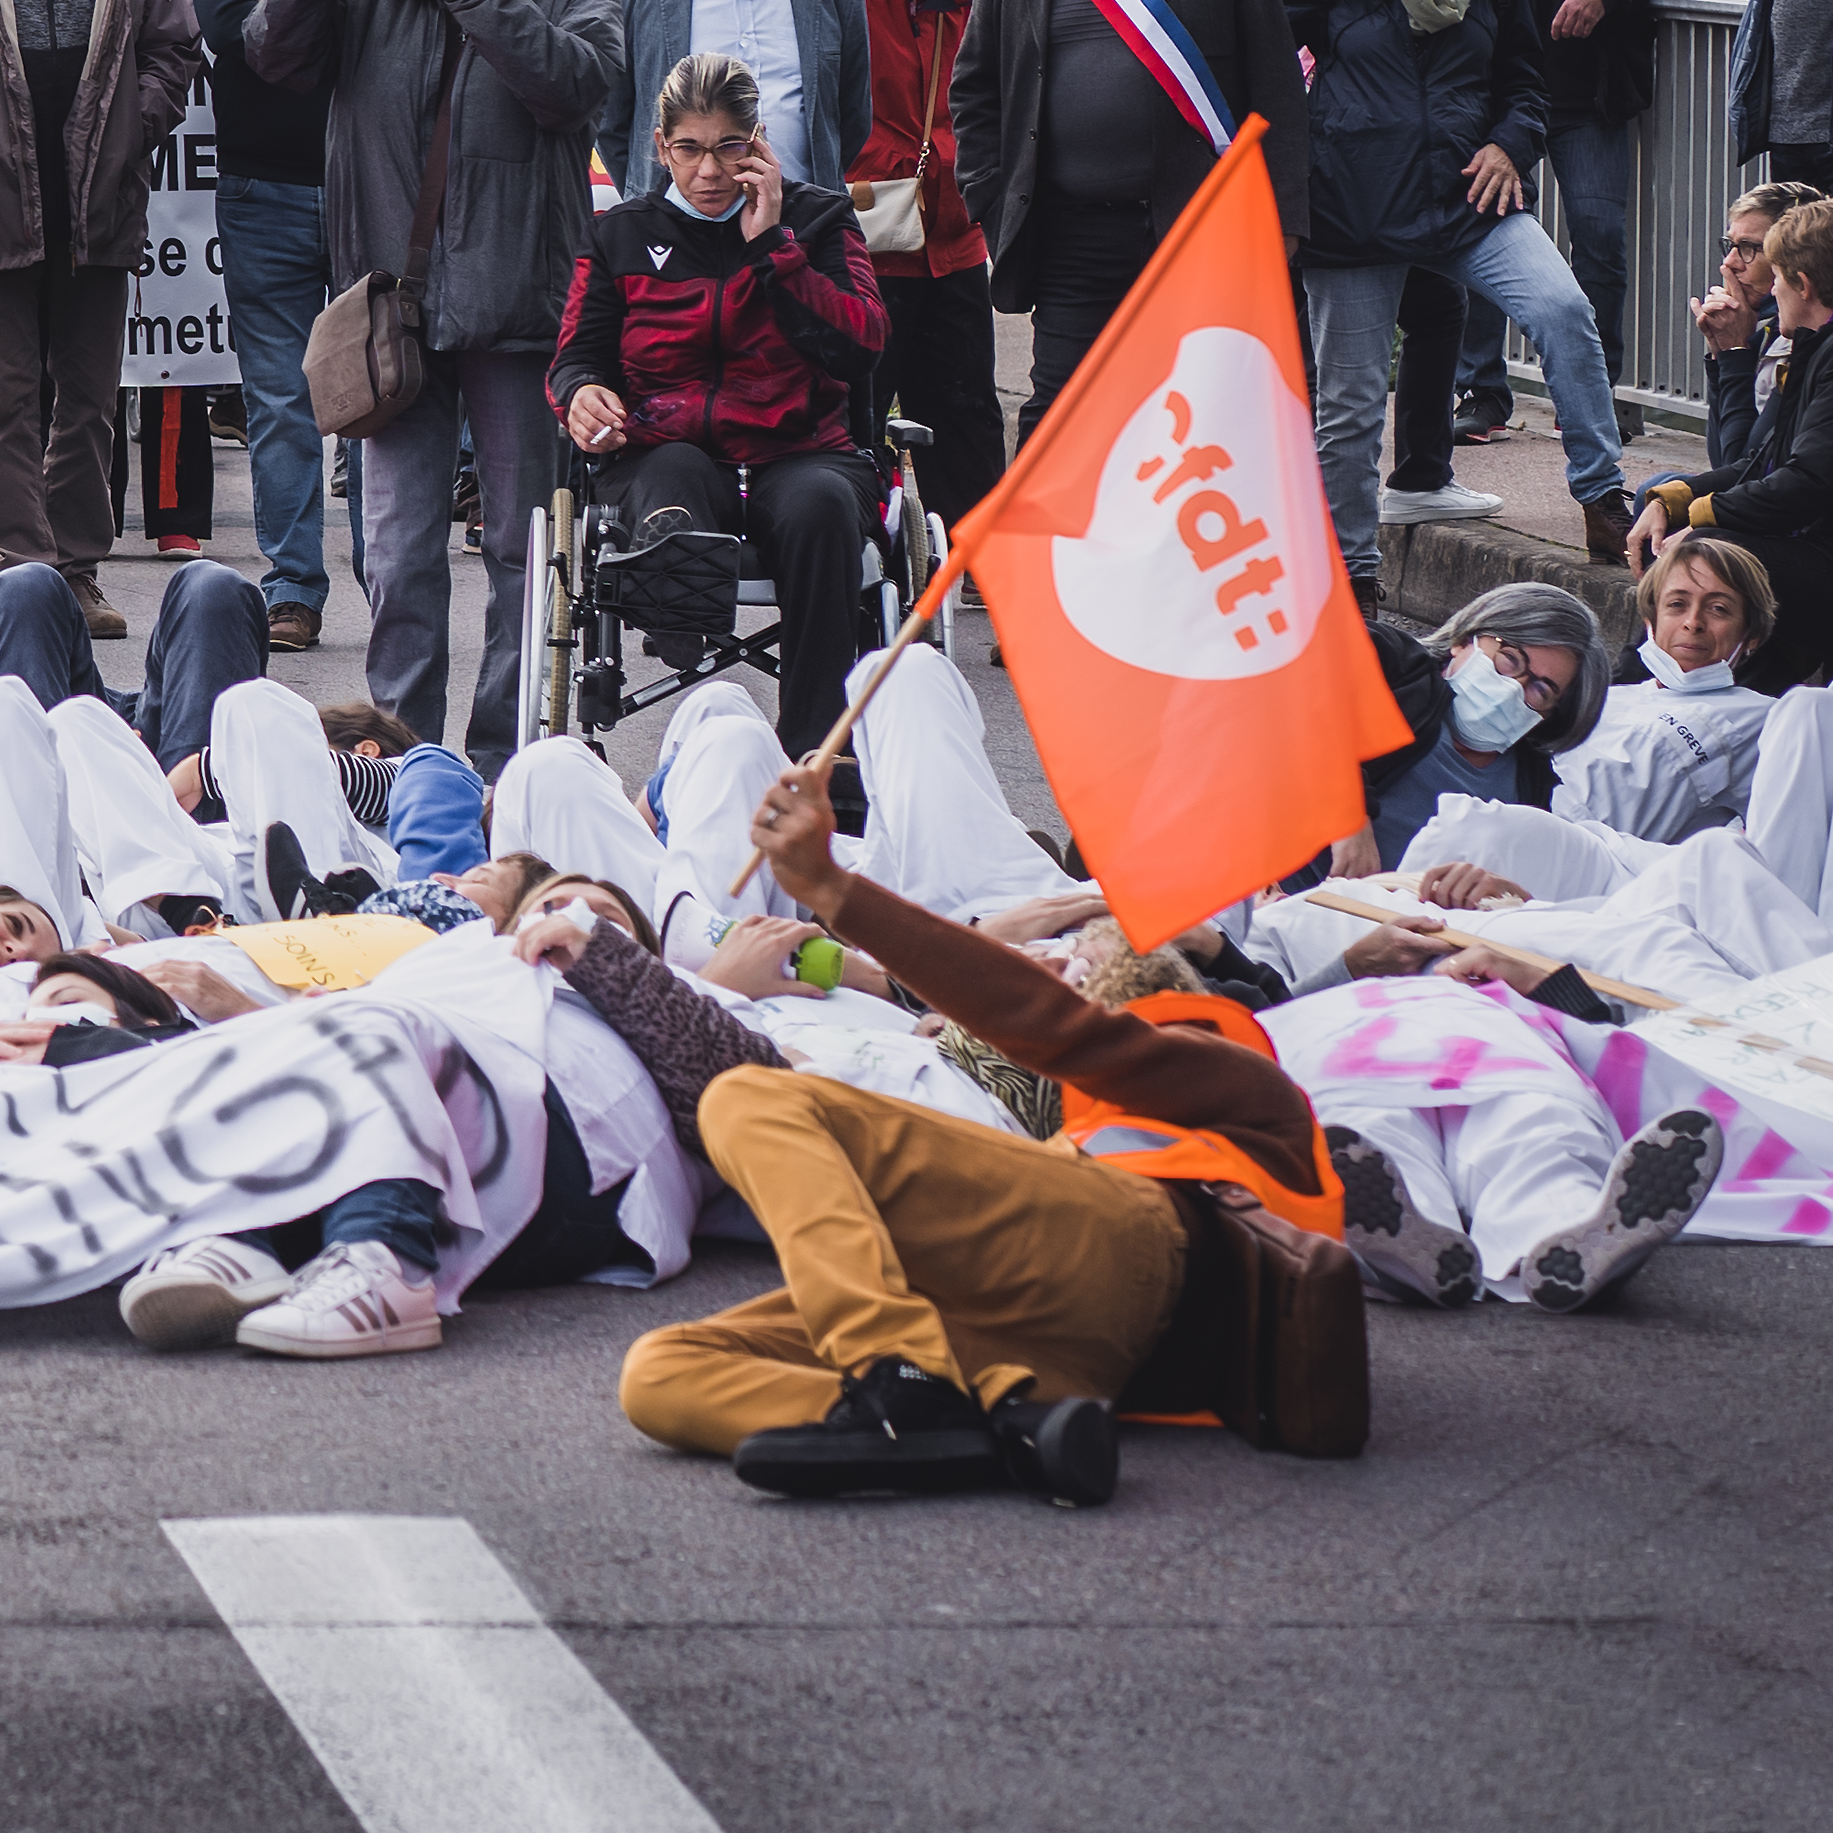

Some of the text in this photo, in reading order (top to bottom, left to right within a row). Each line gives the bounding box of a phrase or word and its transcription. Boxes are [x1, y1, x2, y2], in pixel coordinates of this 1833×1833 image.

[1659, 712, 1710, 766] EN GREVE
[273, 934, 335, 987] SOINS
